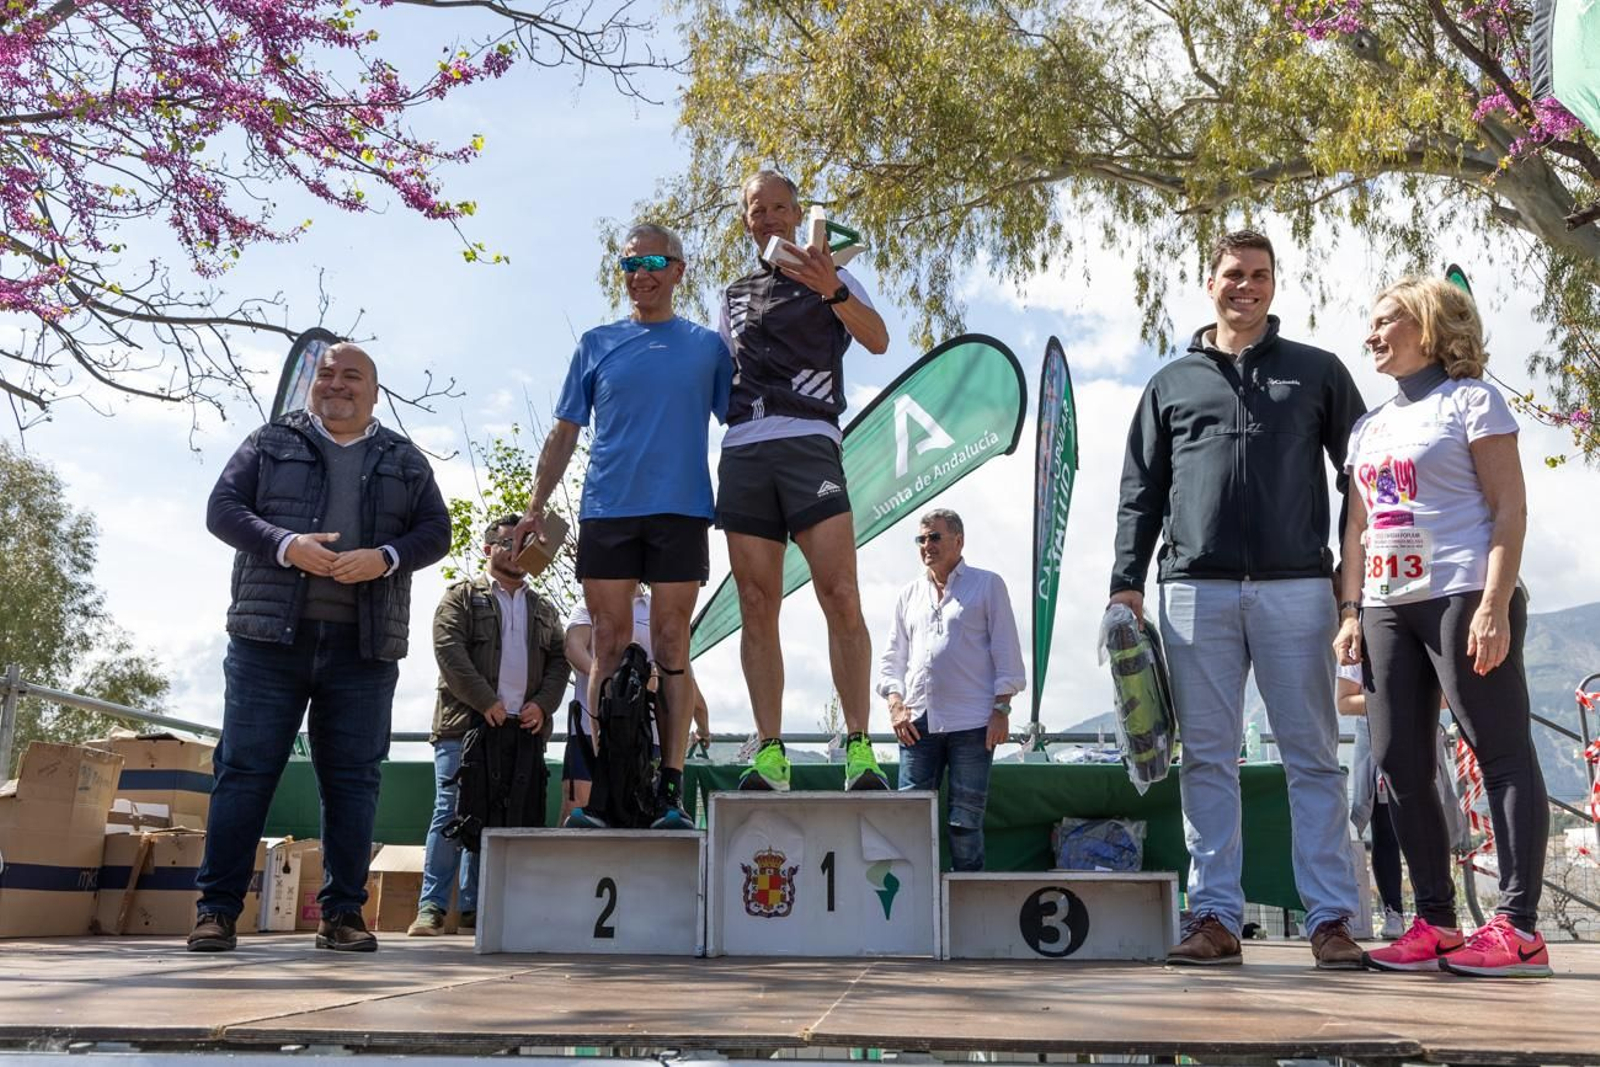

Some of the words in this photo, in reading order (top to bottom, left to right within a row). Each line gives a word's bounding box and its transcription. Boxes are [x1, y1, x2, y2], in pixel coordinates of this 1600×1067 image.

[872, 487, 913, 520] Junta
[915, 475, 932, 492] de
[933, 430, 1000, 480] Andalucía
[593, 876, 618, 939] 2
[820, 851, 836, 912] 1
[1038, 892, 1073, 954] 3
